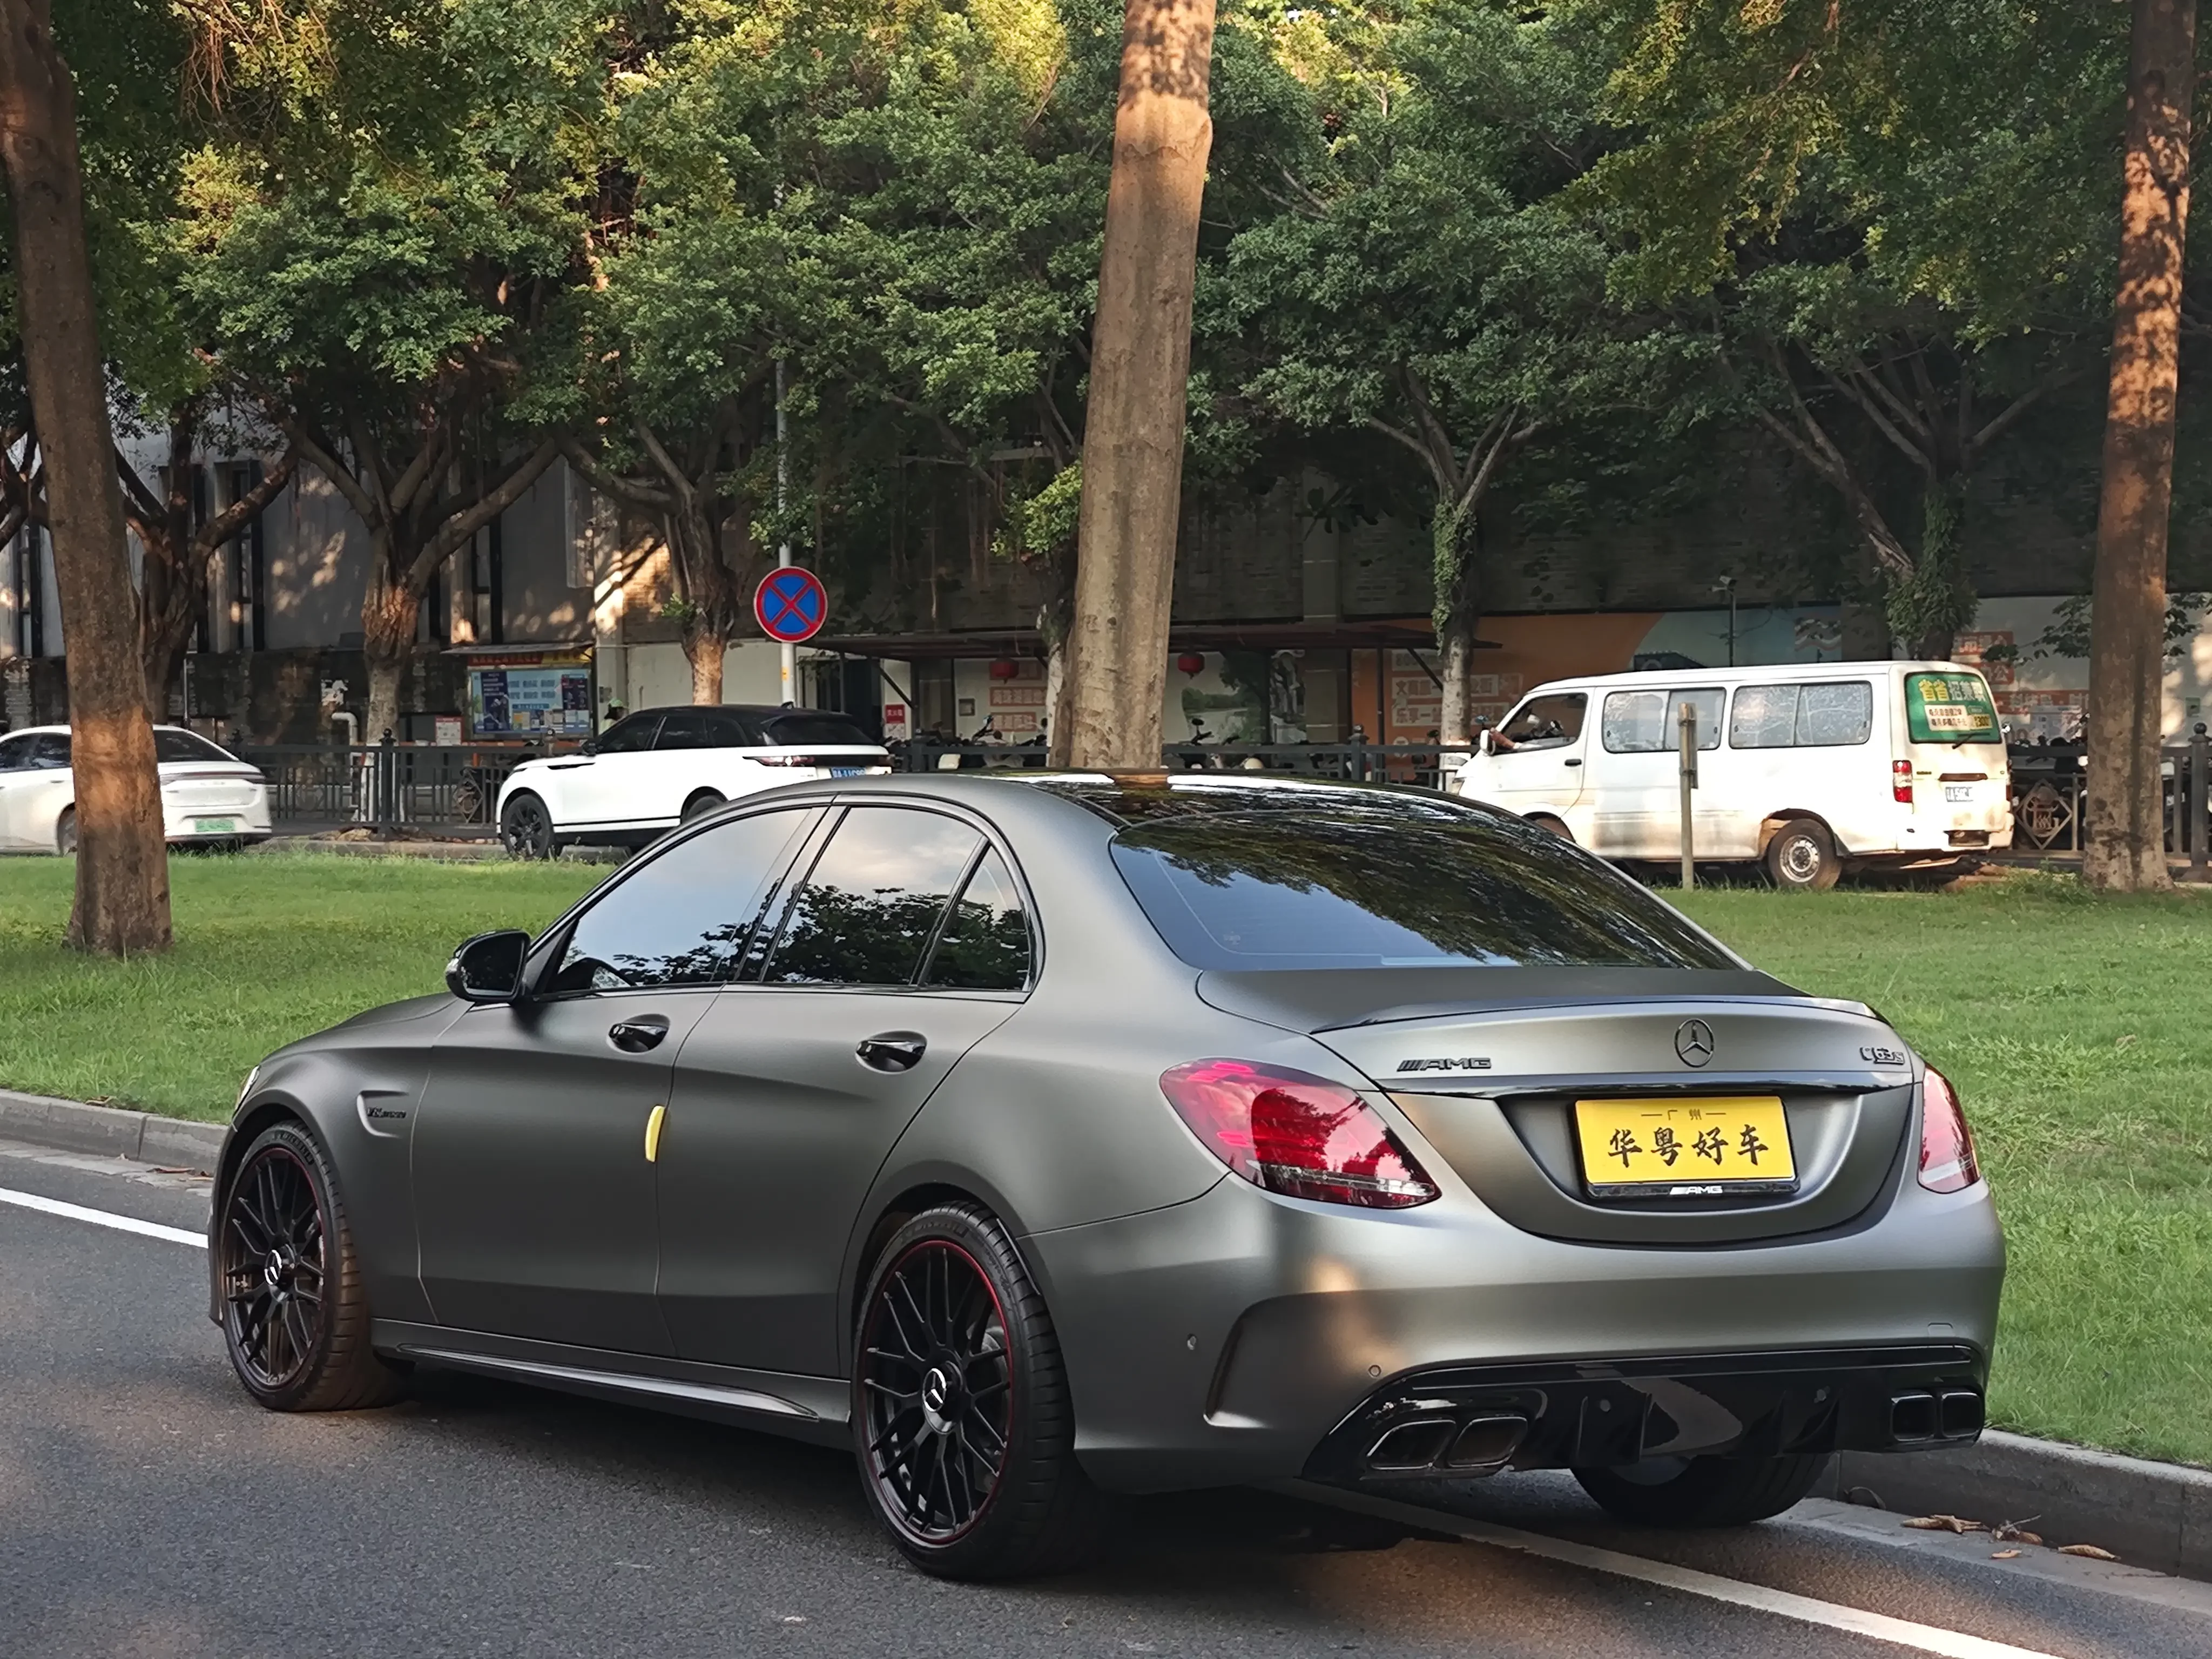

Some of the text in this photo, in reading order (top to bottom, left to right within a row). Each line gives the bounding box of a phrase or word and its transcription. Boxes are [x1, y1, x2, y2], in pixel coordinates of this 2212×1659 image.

[1667, 1108, 1702, 1121] 广州
[1607, 1124, 1769, 1168] 华粤好车
[1685, 1185, 1723, 1194] AMG
